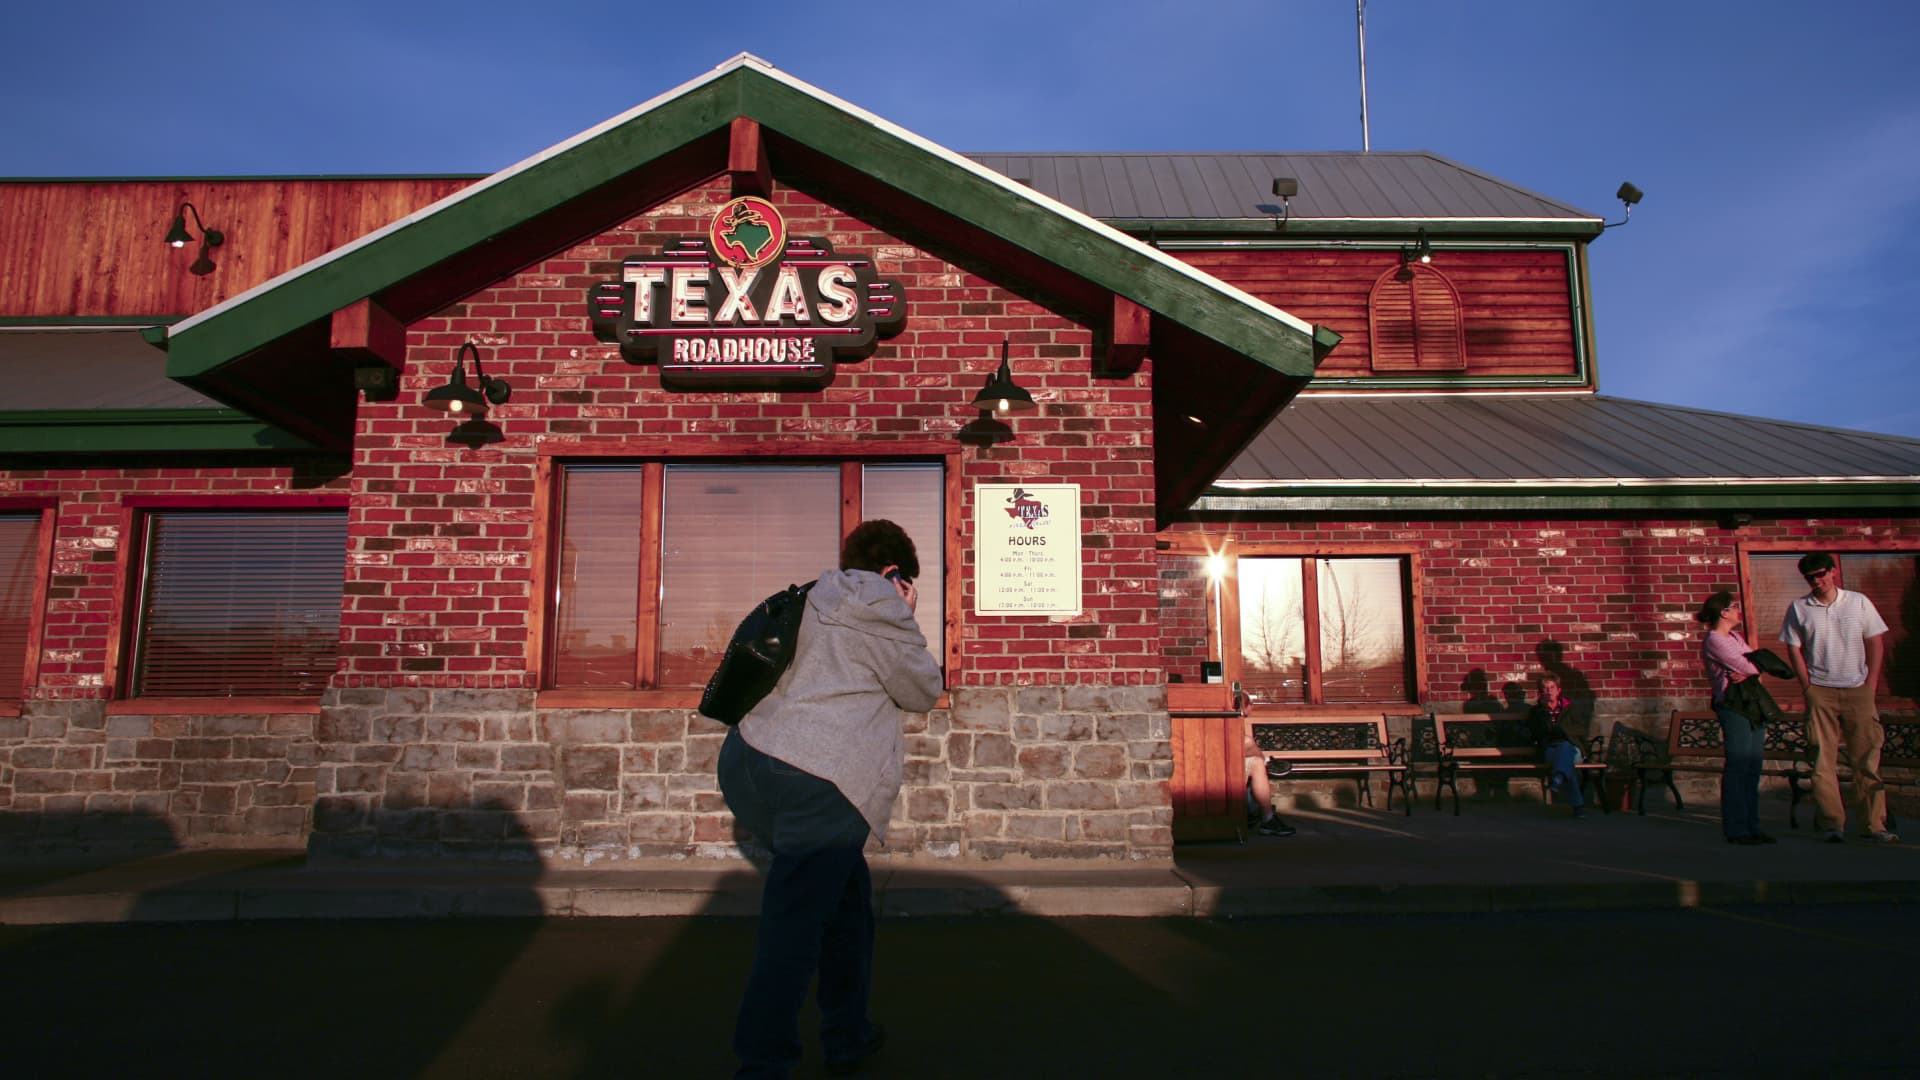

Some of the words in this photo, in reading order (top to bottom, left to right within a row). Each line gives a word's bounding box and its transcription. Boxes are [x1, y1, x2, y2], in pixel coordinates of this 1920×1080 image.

[623, 264, 858, 326] TEXAS
[673, 337, 816, 364] ROADHOUSE
[1018, 504, 1049, 518] TEXAS
[1008, 536, 1046, 546] HOURS
